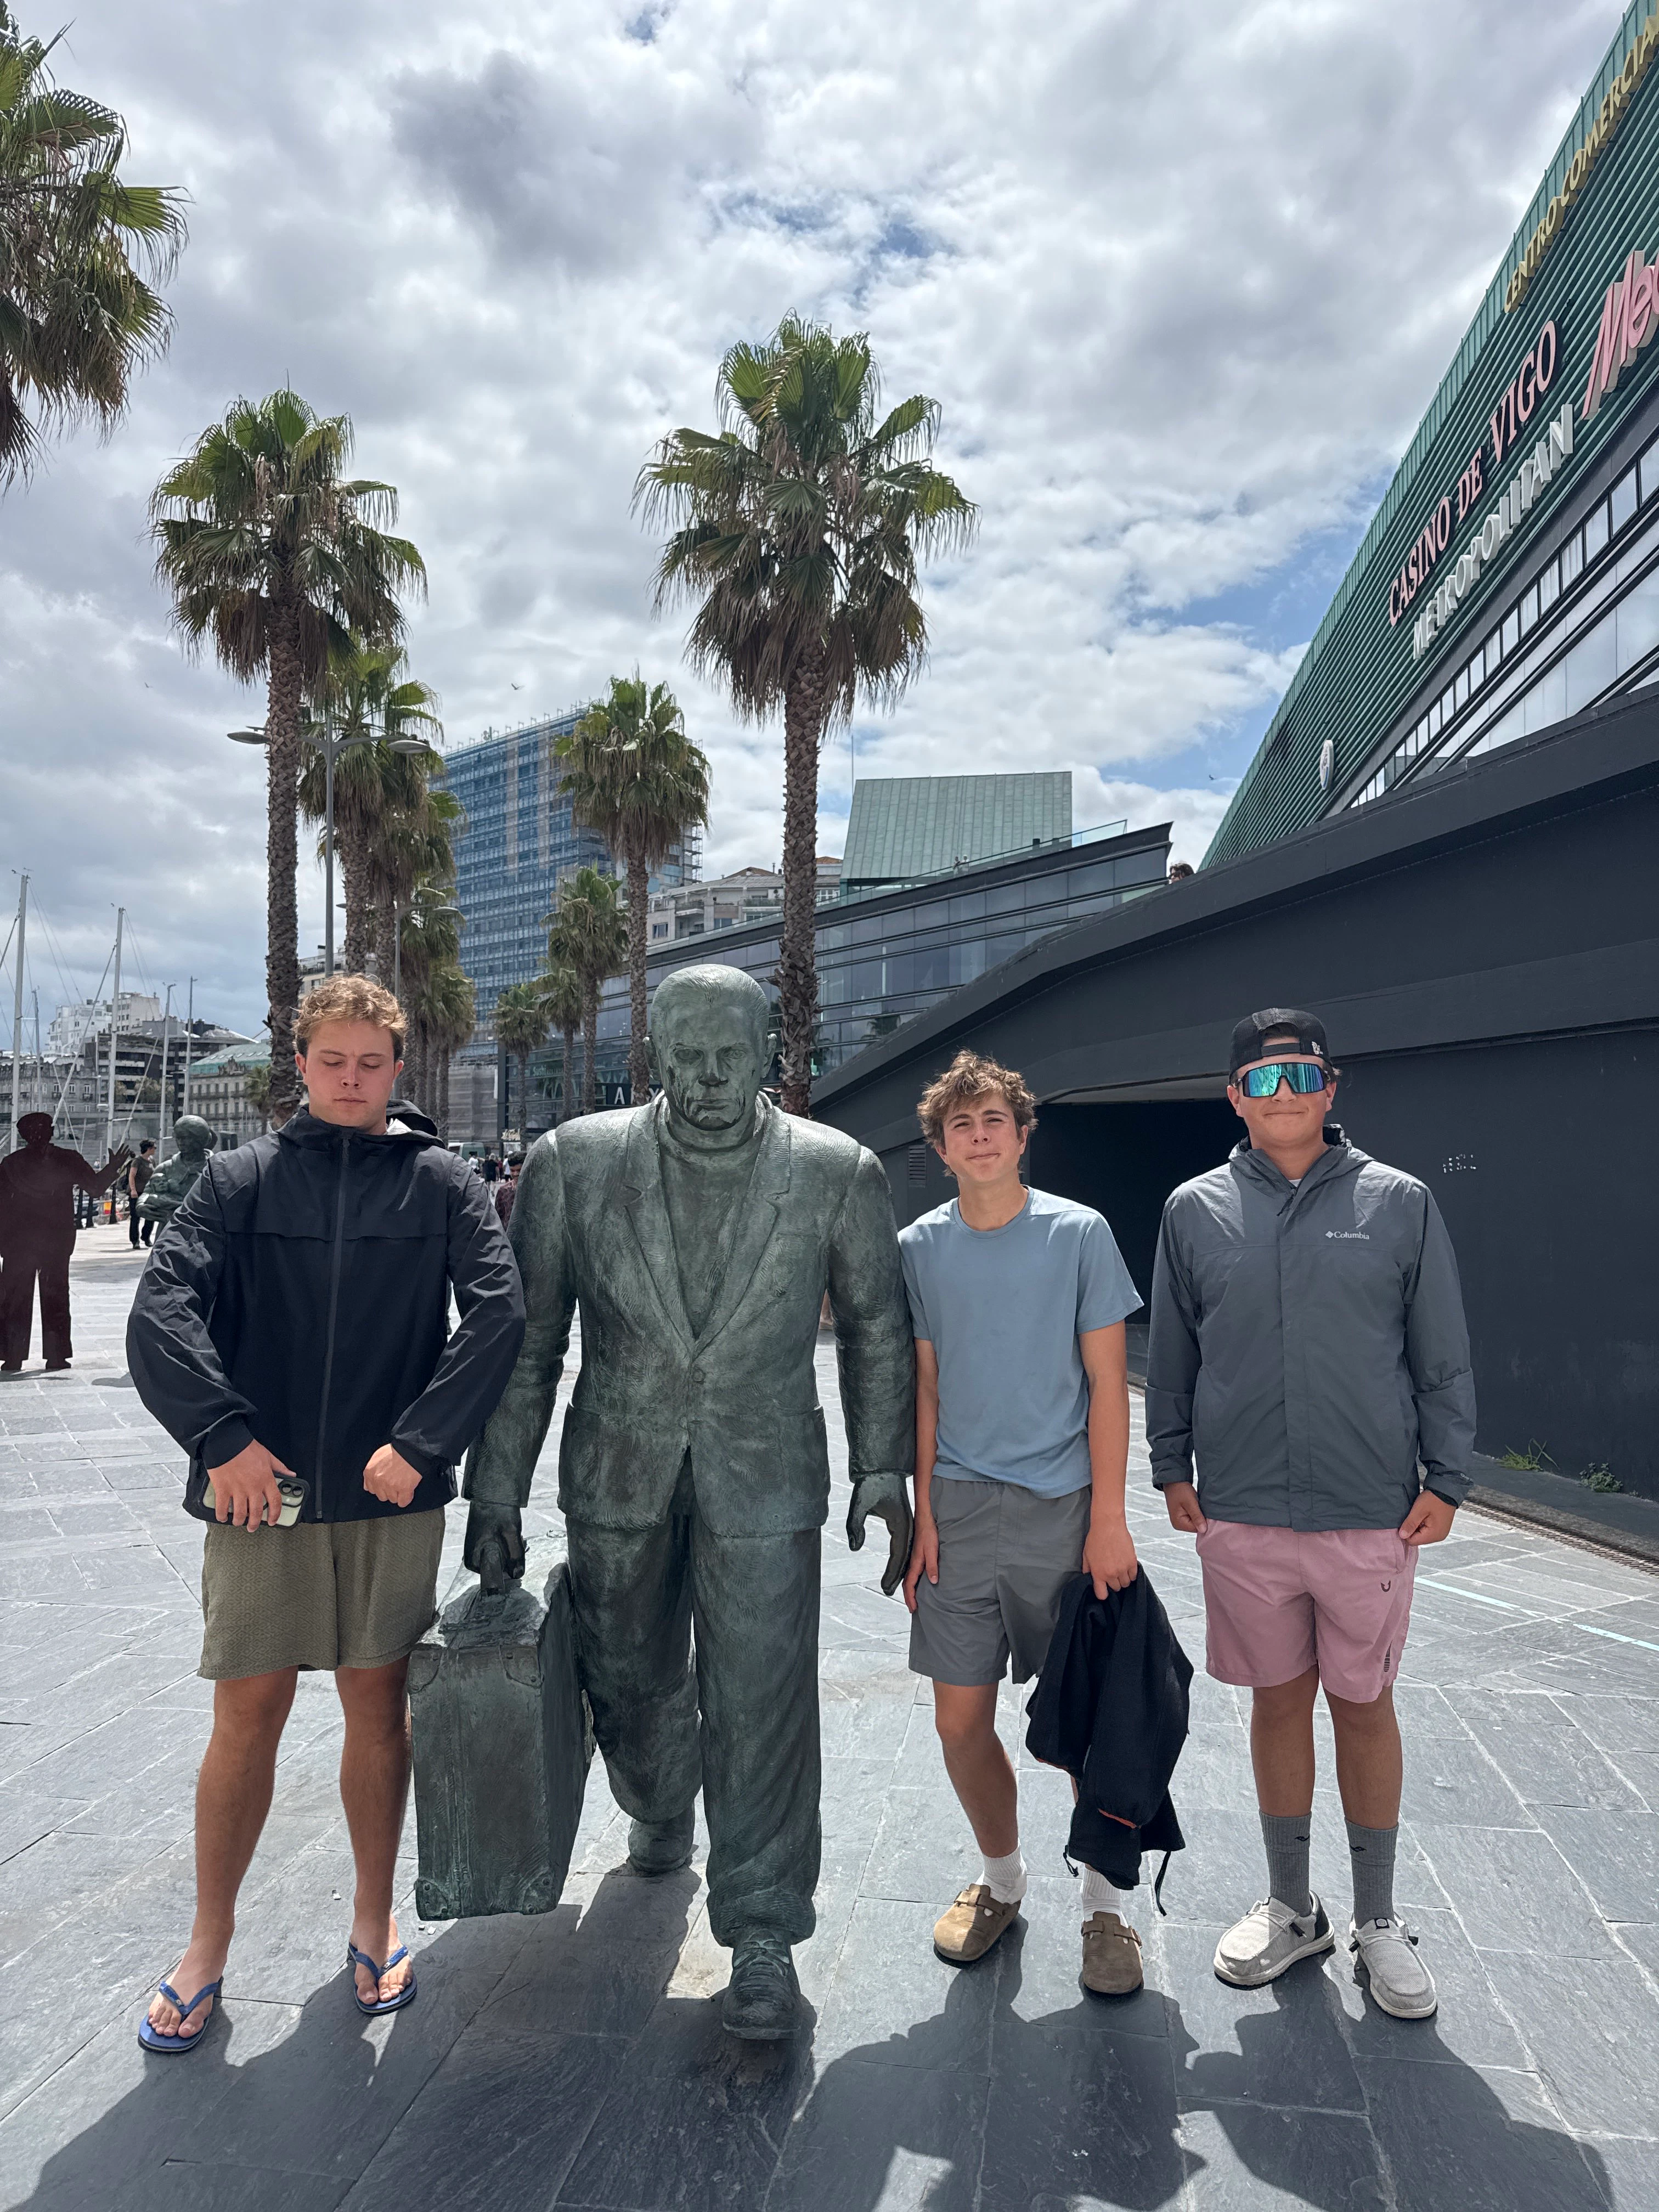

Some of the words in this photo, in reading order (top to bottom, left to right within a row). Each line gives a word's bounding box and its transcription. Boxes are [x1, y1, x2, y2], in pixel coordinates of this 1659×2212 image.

[1504, 196, 1564, 313] CENTRO
[1561, 0, 1659, 207] COMERCIA
[1389, 496, 1451, 627] CASINO
[1458, 453, 1483, 524] DE
[1489, 320, 1558, 463] VIGO
[1413, 404, 1573, 659] METROPOLITAN
[1334, 1231, 1370, 1240] Columbia
